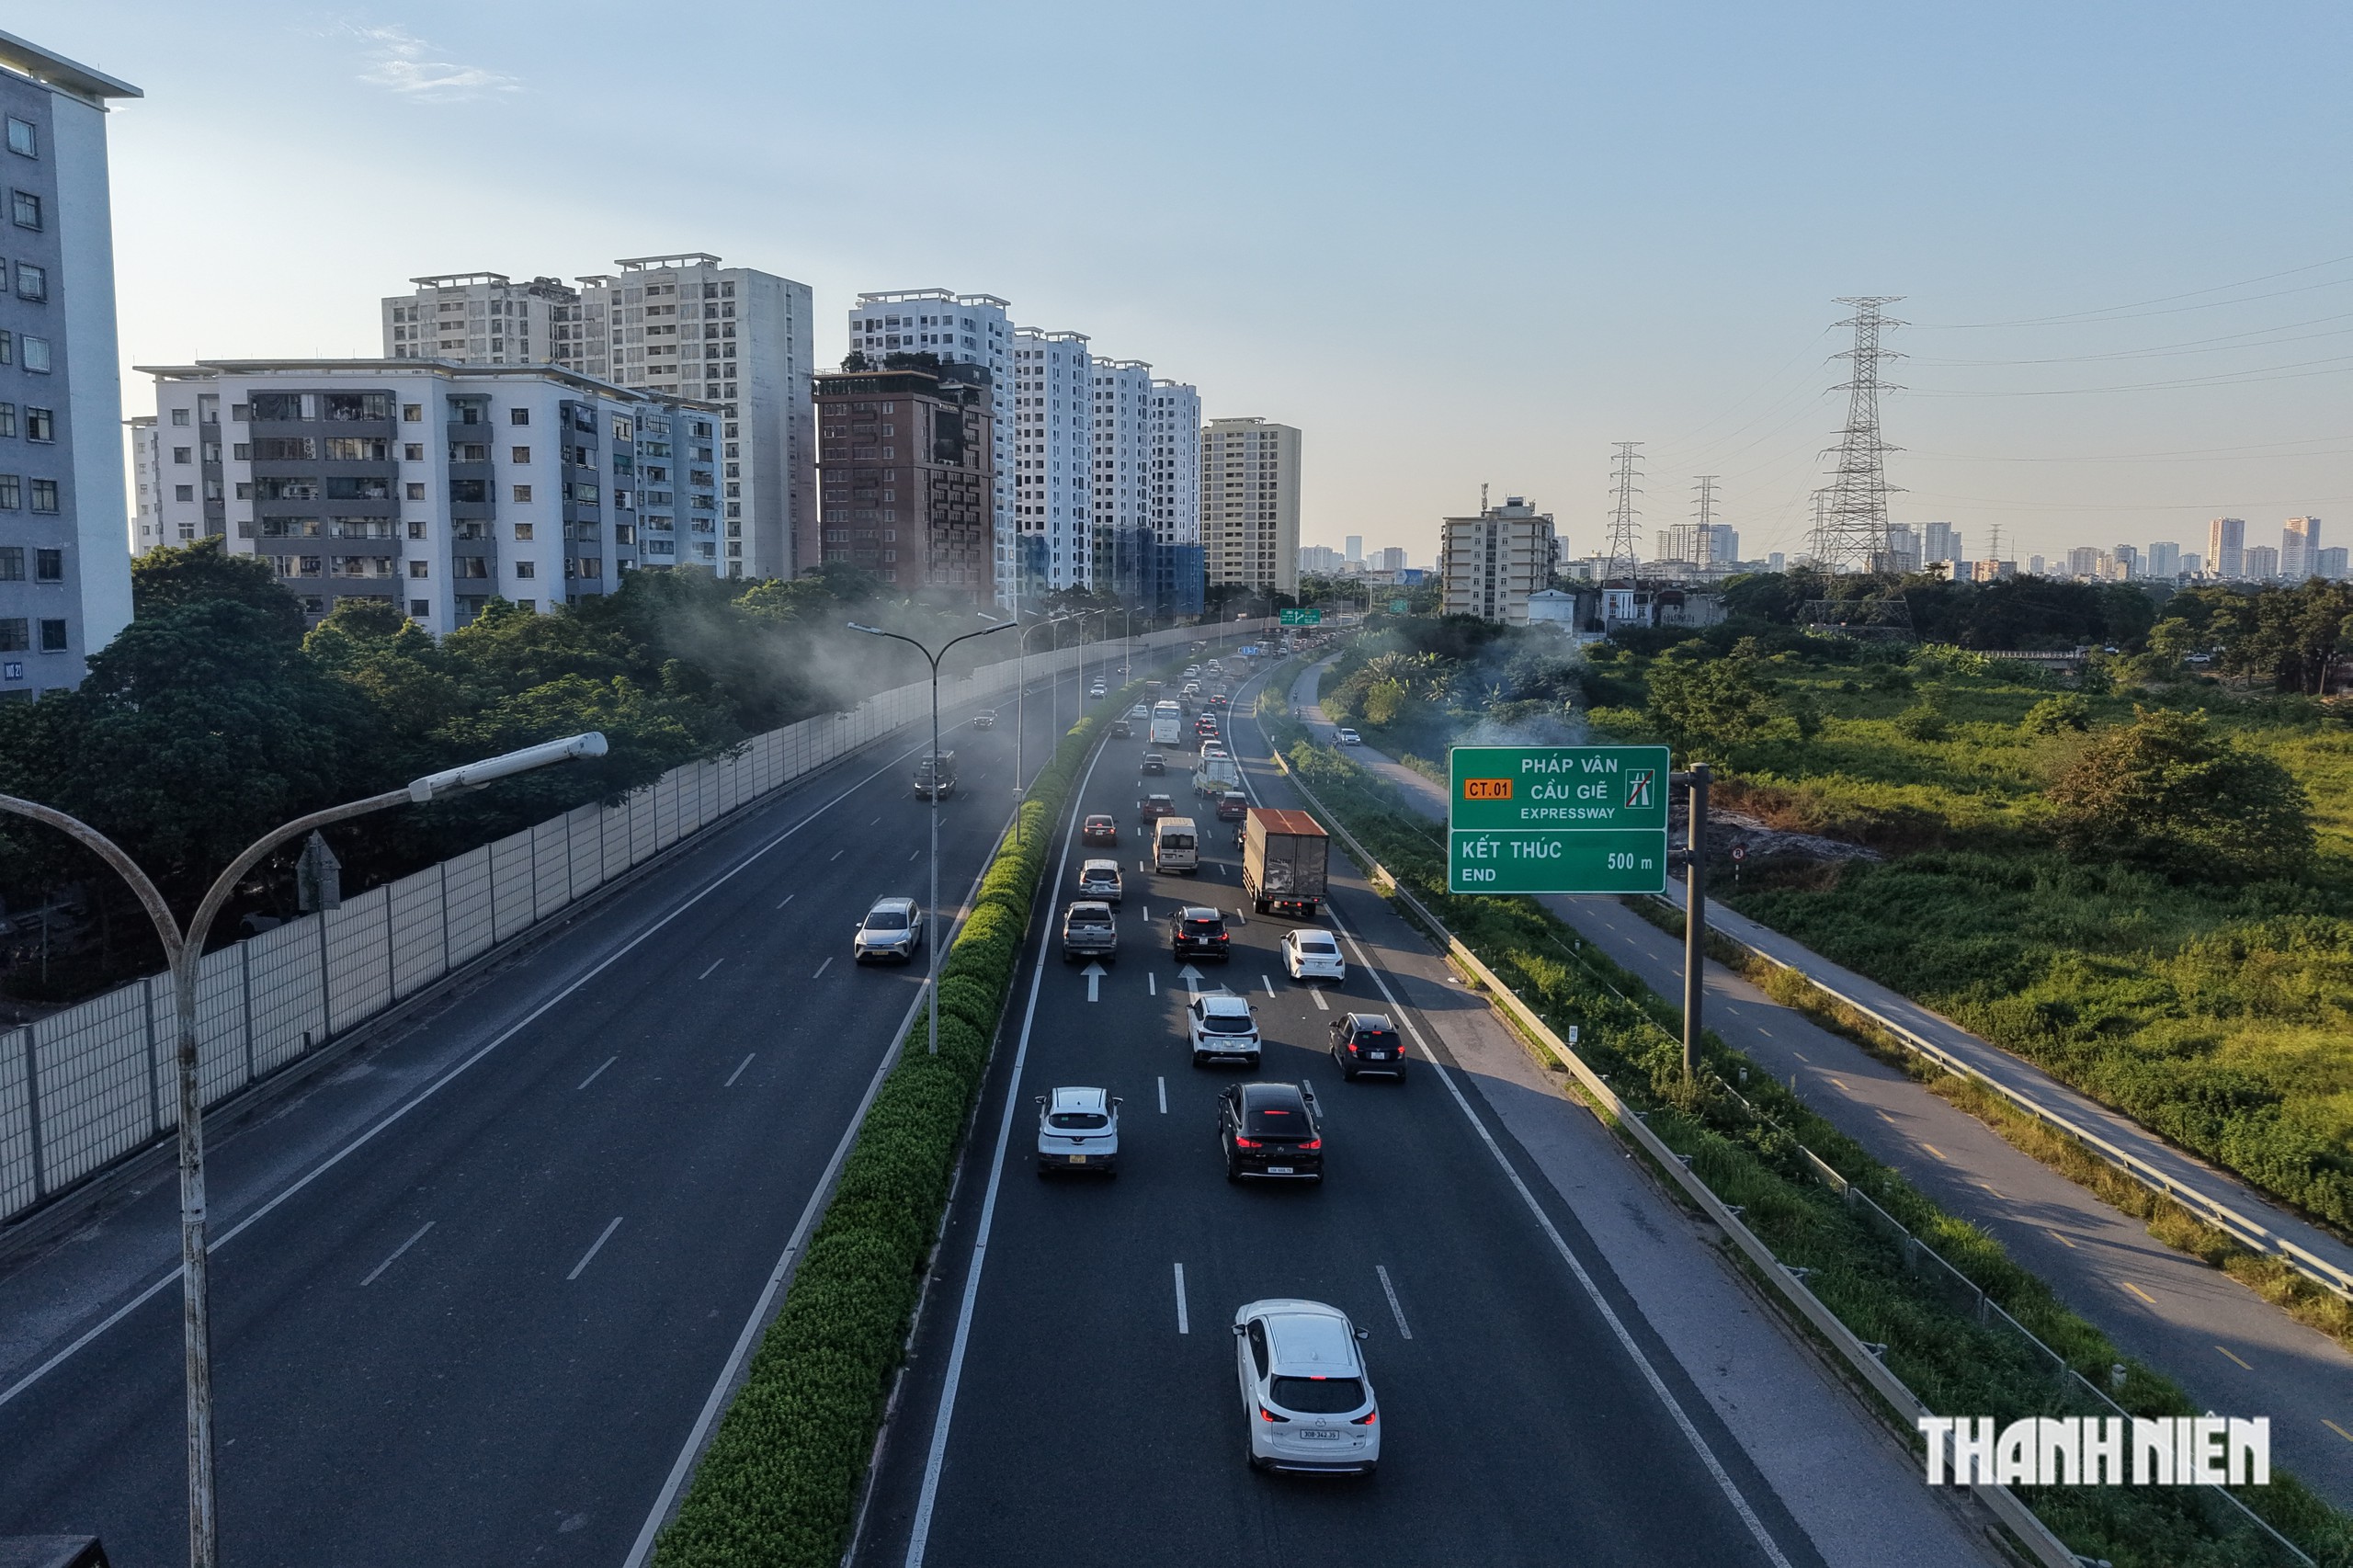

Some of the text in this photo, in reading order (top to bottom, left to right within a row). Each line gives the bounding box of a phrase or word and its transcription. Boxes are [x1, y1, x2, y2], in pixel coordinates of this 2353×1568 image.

[1521, 753, 1618, 774] PHÁP VÂN
[1469, 781, 1508, 797] CT.01
[1530, 778, 1608, 800] CẦU GIẼ
[1520, 807, 1616, 820] EXPRESSWAY
[1462, 834, 1563, 858] KẾT THÚC
[1608, 852, 1653, 870] 500 m
[1462, 869, 1496, 881] END
